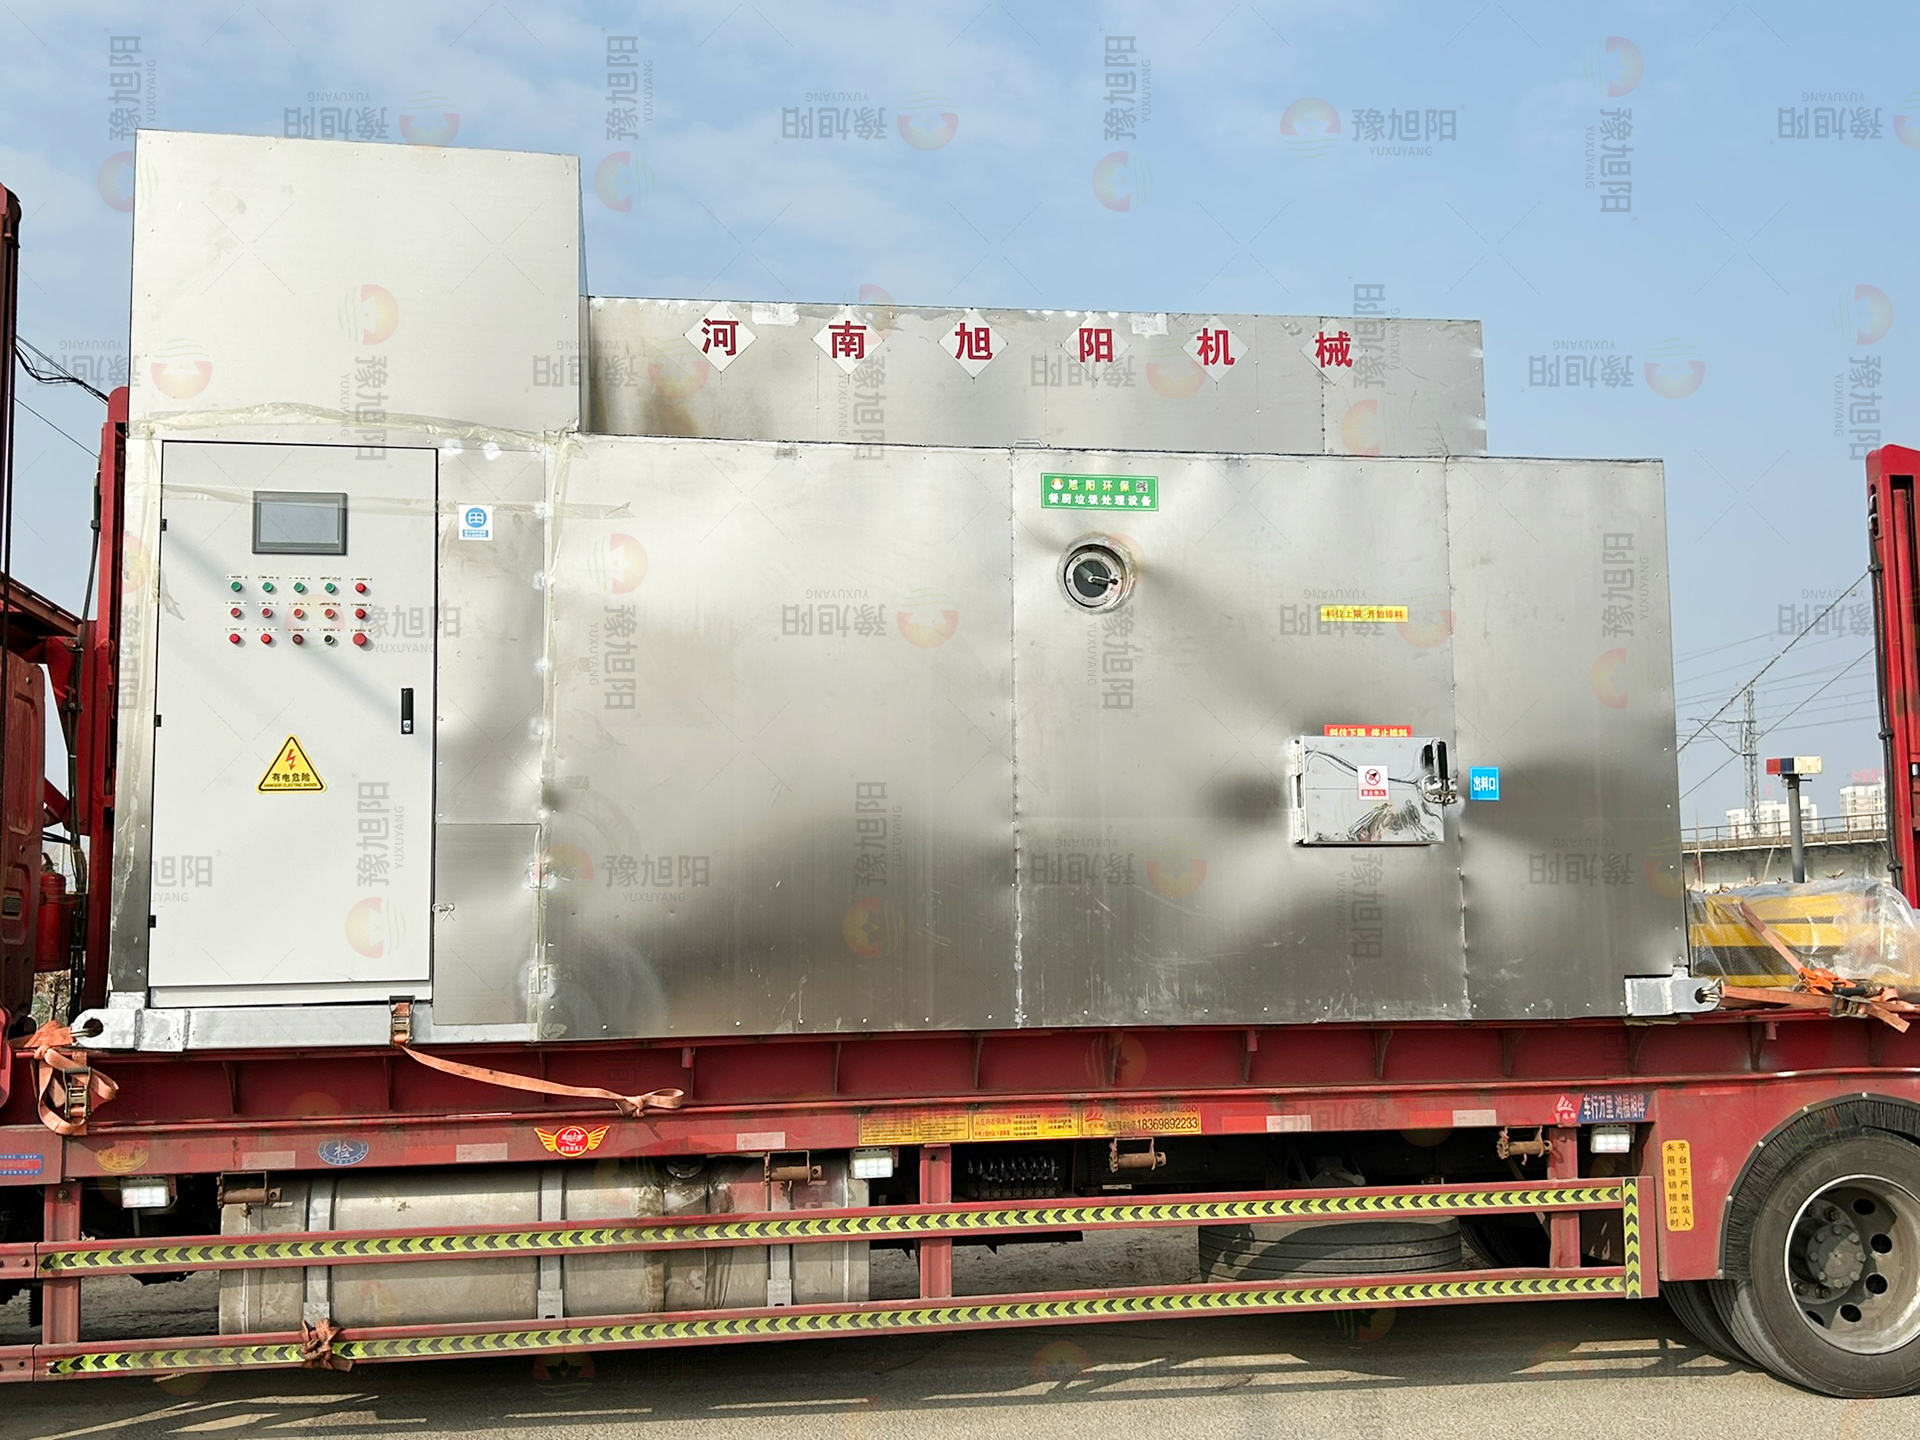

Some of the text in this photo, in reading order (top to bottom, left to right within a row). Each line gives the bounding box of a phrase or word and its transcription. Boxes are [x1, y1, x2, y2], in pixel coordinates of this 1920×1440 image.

[701, 318, 1353, 368] 河南旭阳机械
[1068, 479, 1130, 492] 旭阳环保
[1048, 493, 1151, 507] 餐厨垃圾处理设备
[272, 772, 311, 783] 有电危险
[1473, 775, 1496, 792] 出料口
[1583, 1094, 1614, 1119] 车行万里
[1137, 1117, 1198, 1131] 18369892233
[333, 1140, 354, 1160] 检
[1678, 1142, 1691, 1227] 平台下严禁站人
